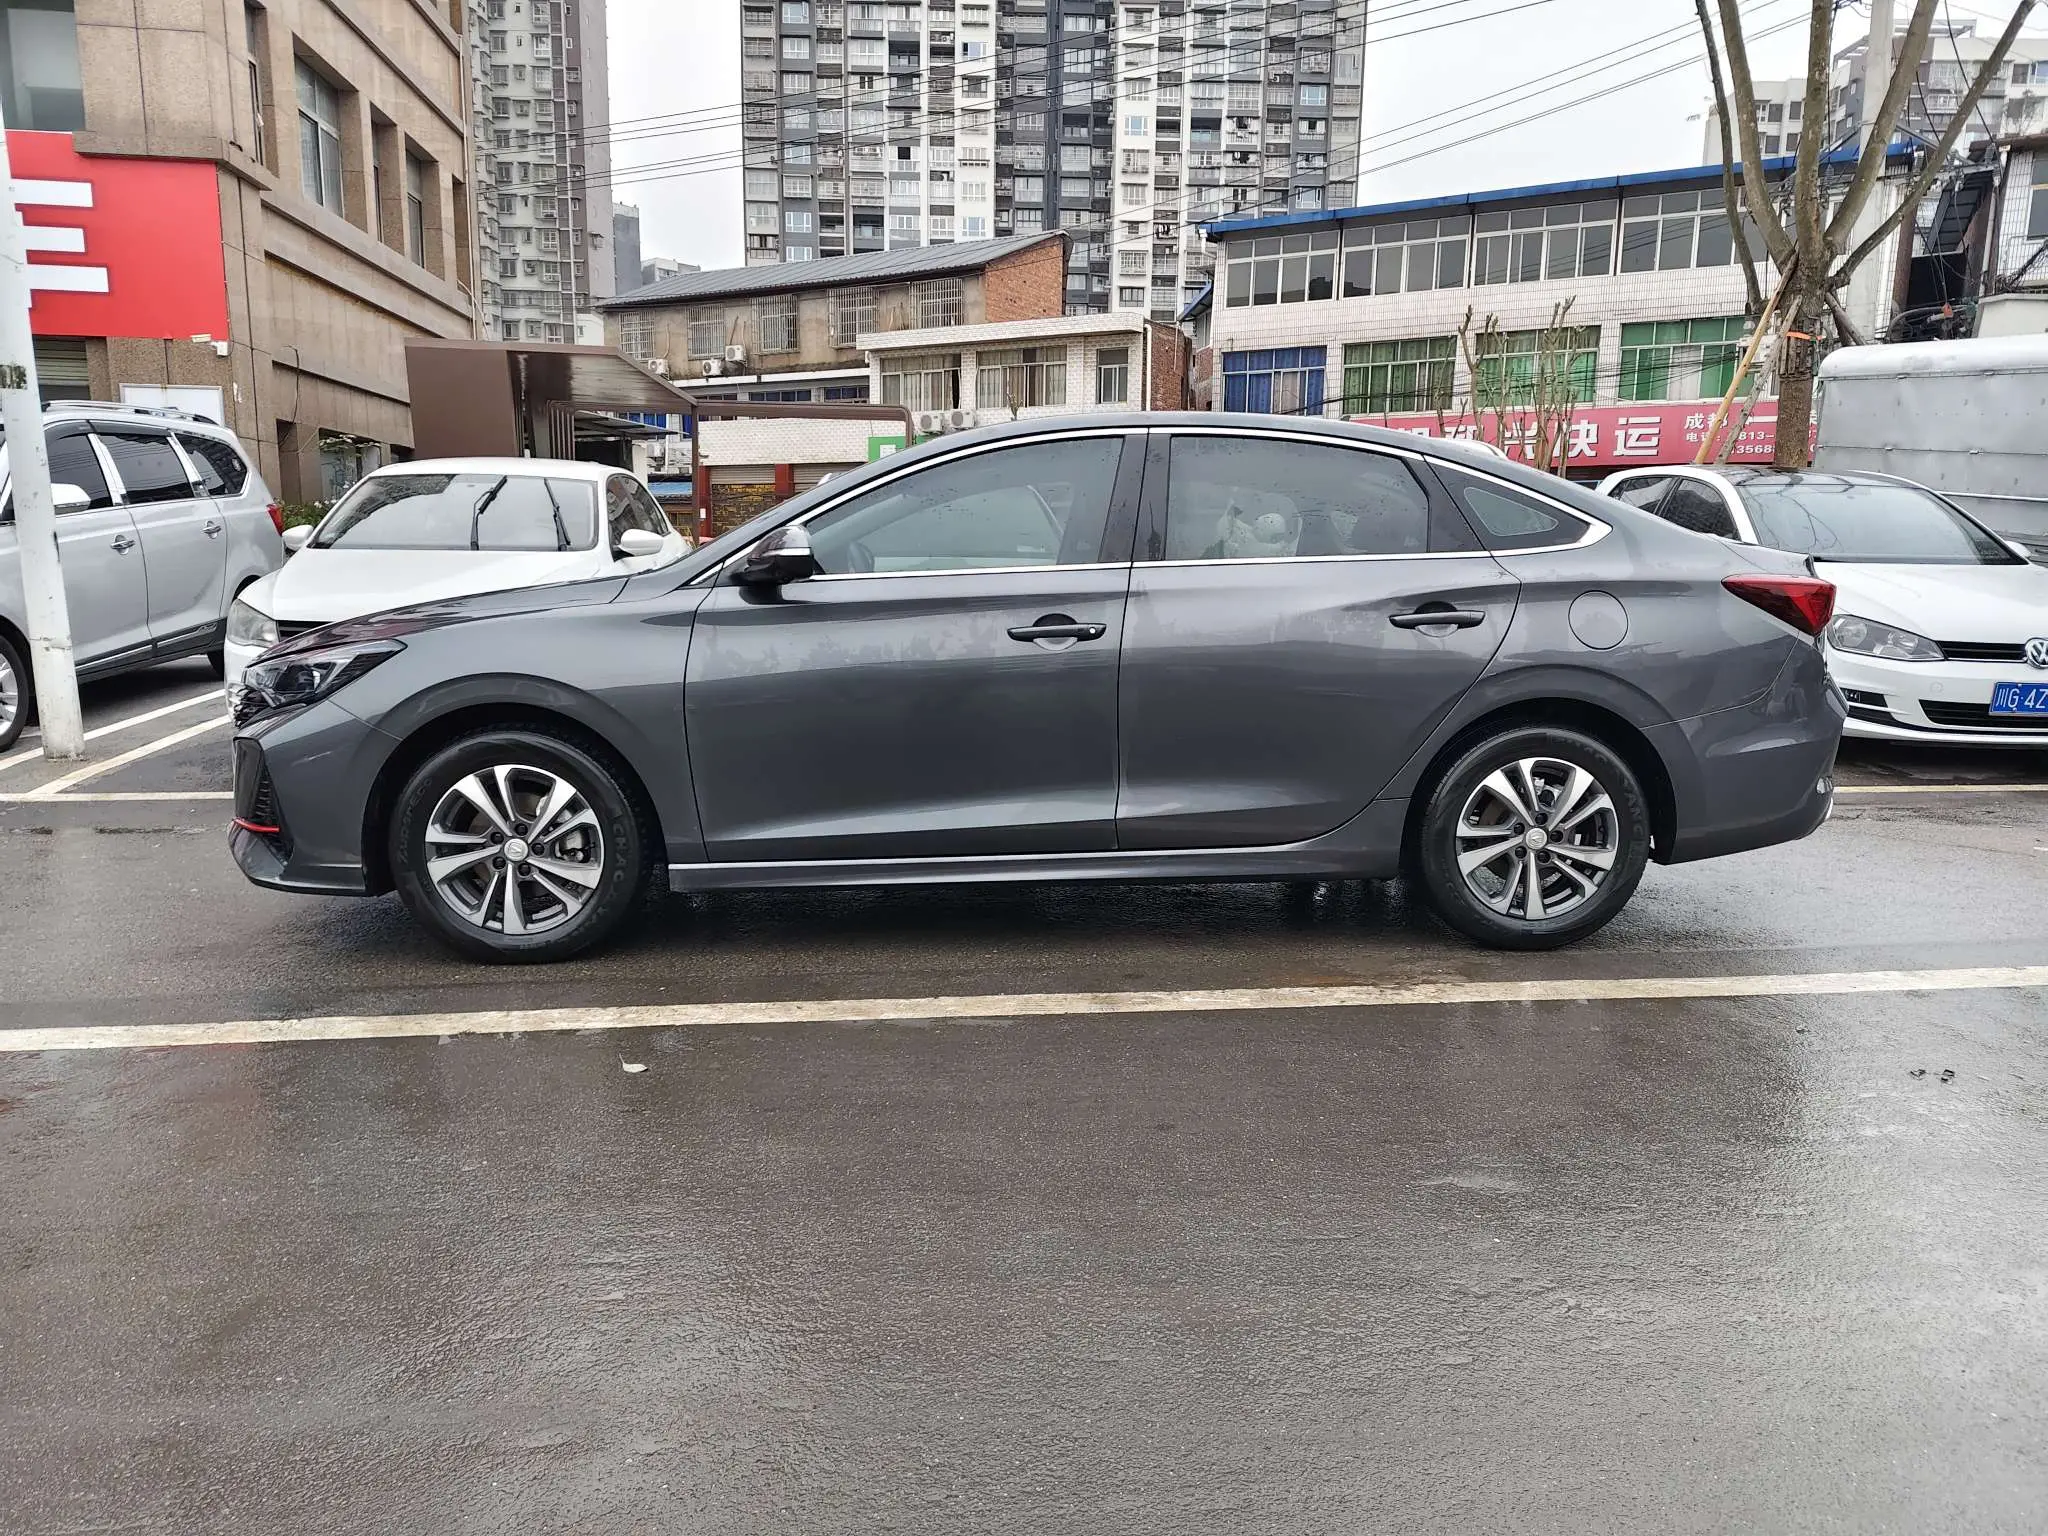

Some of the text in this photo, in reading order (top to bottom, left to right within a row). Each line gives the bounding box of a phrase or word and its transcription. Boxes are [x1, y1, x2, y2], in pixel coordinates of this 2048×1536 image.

[1398, 416, 1662, 460] 兴快运
[1731, 444, 1776, 455] 3568
